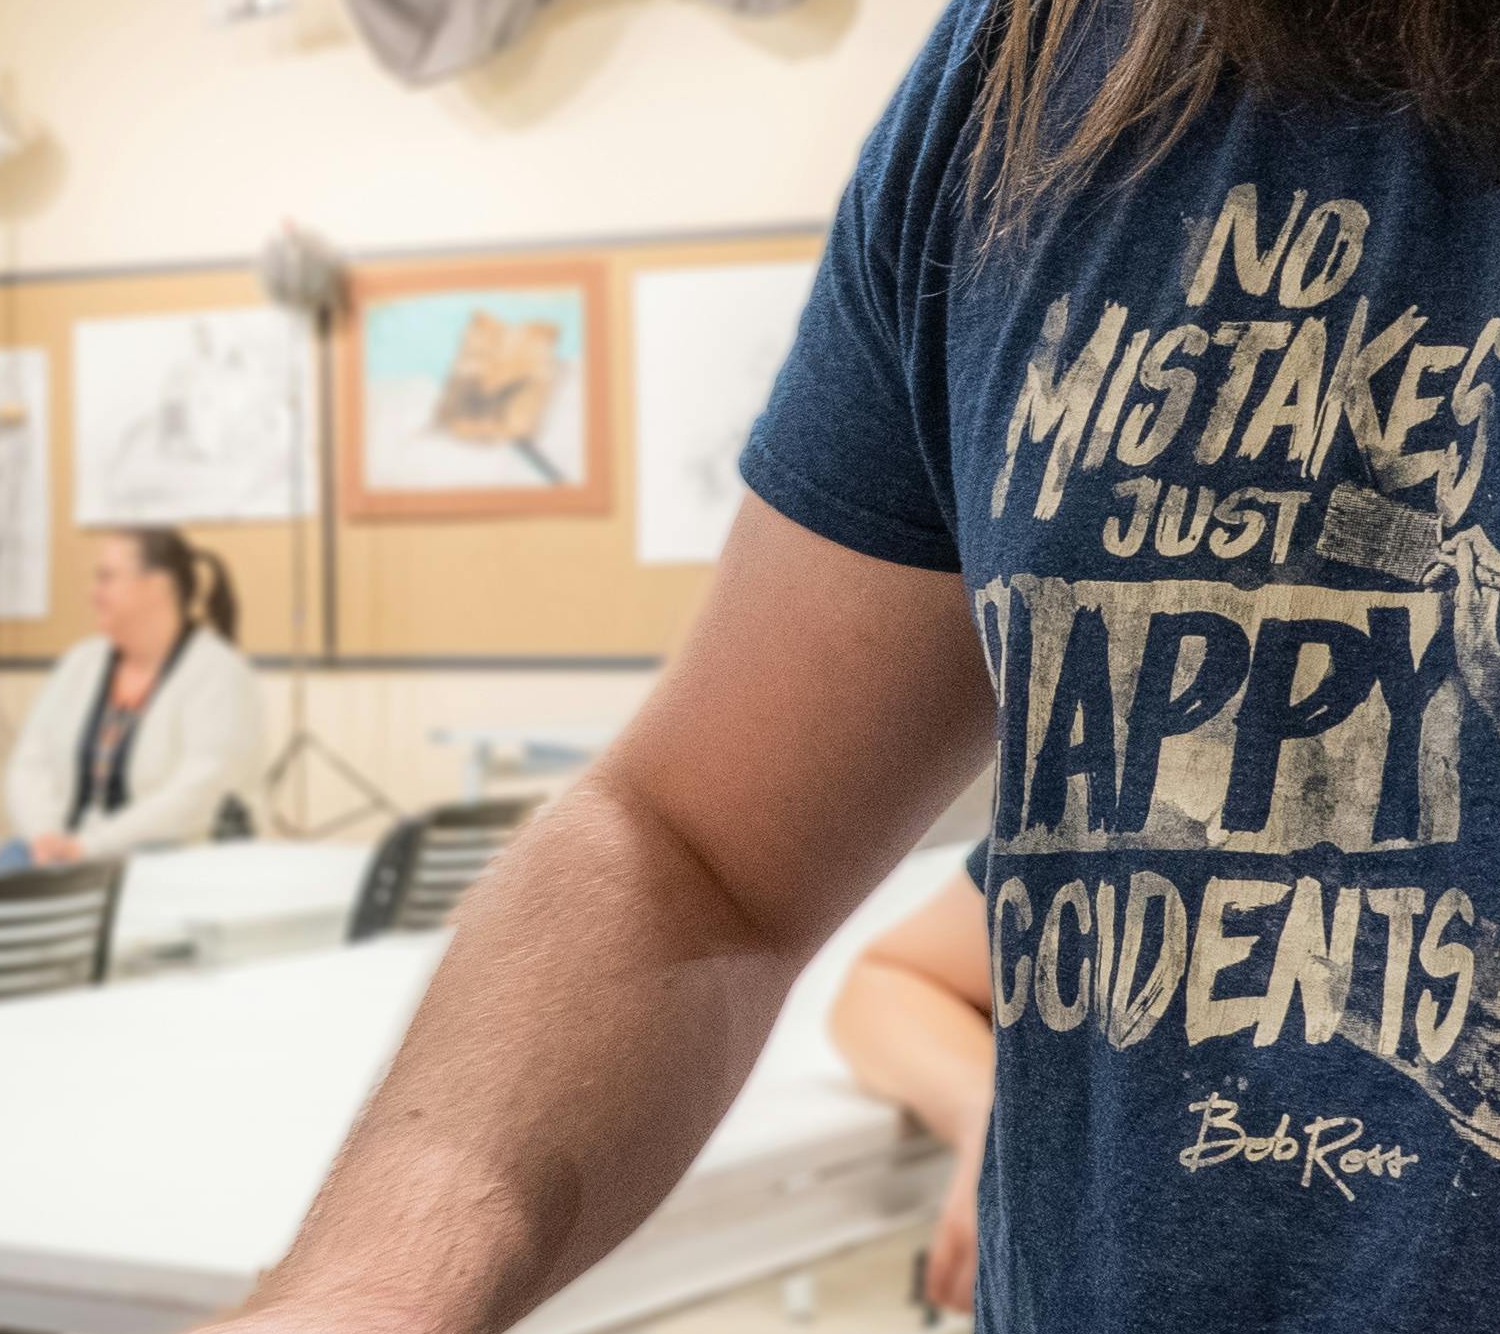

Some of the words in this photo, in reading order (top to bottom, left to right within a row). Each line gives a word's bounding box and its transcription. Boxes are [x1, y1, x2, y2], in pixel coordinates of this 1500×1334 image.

[1186, 181, 1371, 309] NO
[1102, 476, 1311, 566] JUST
[992, 869, 1476, 1062] CCIDENTS
[1179, 1091, 1299, 1173] Bob
[1302, 1116, 1419, 1201] Ross
